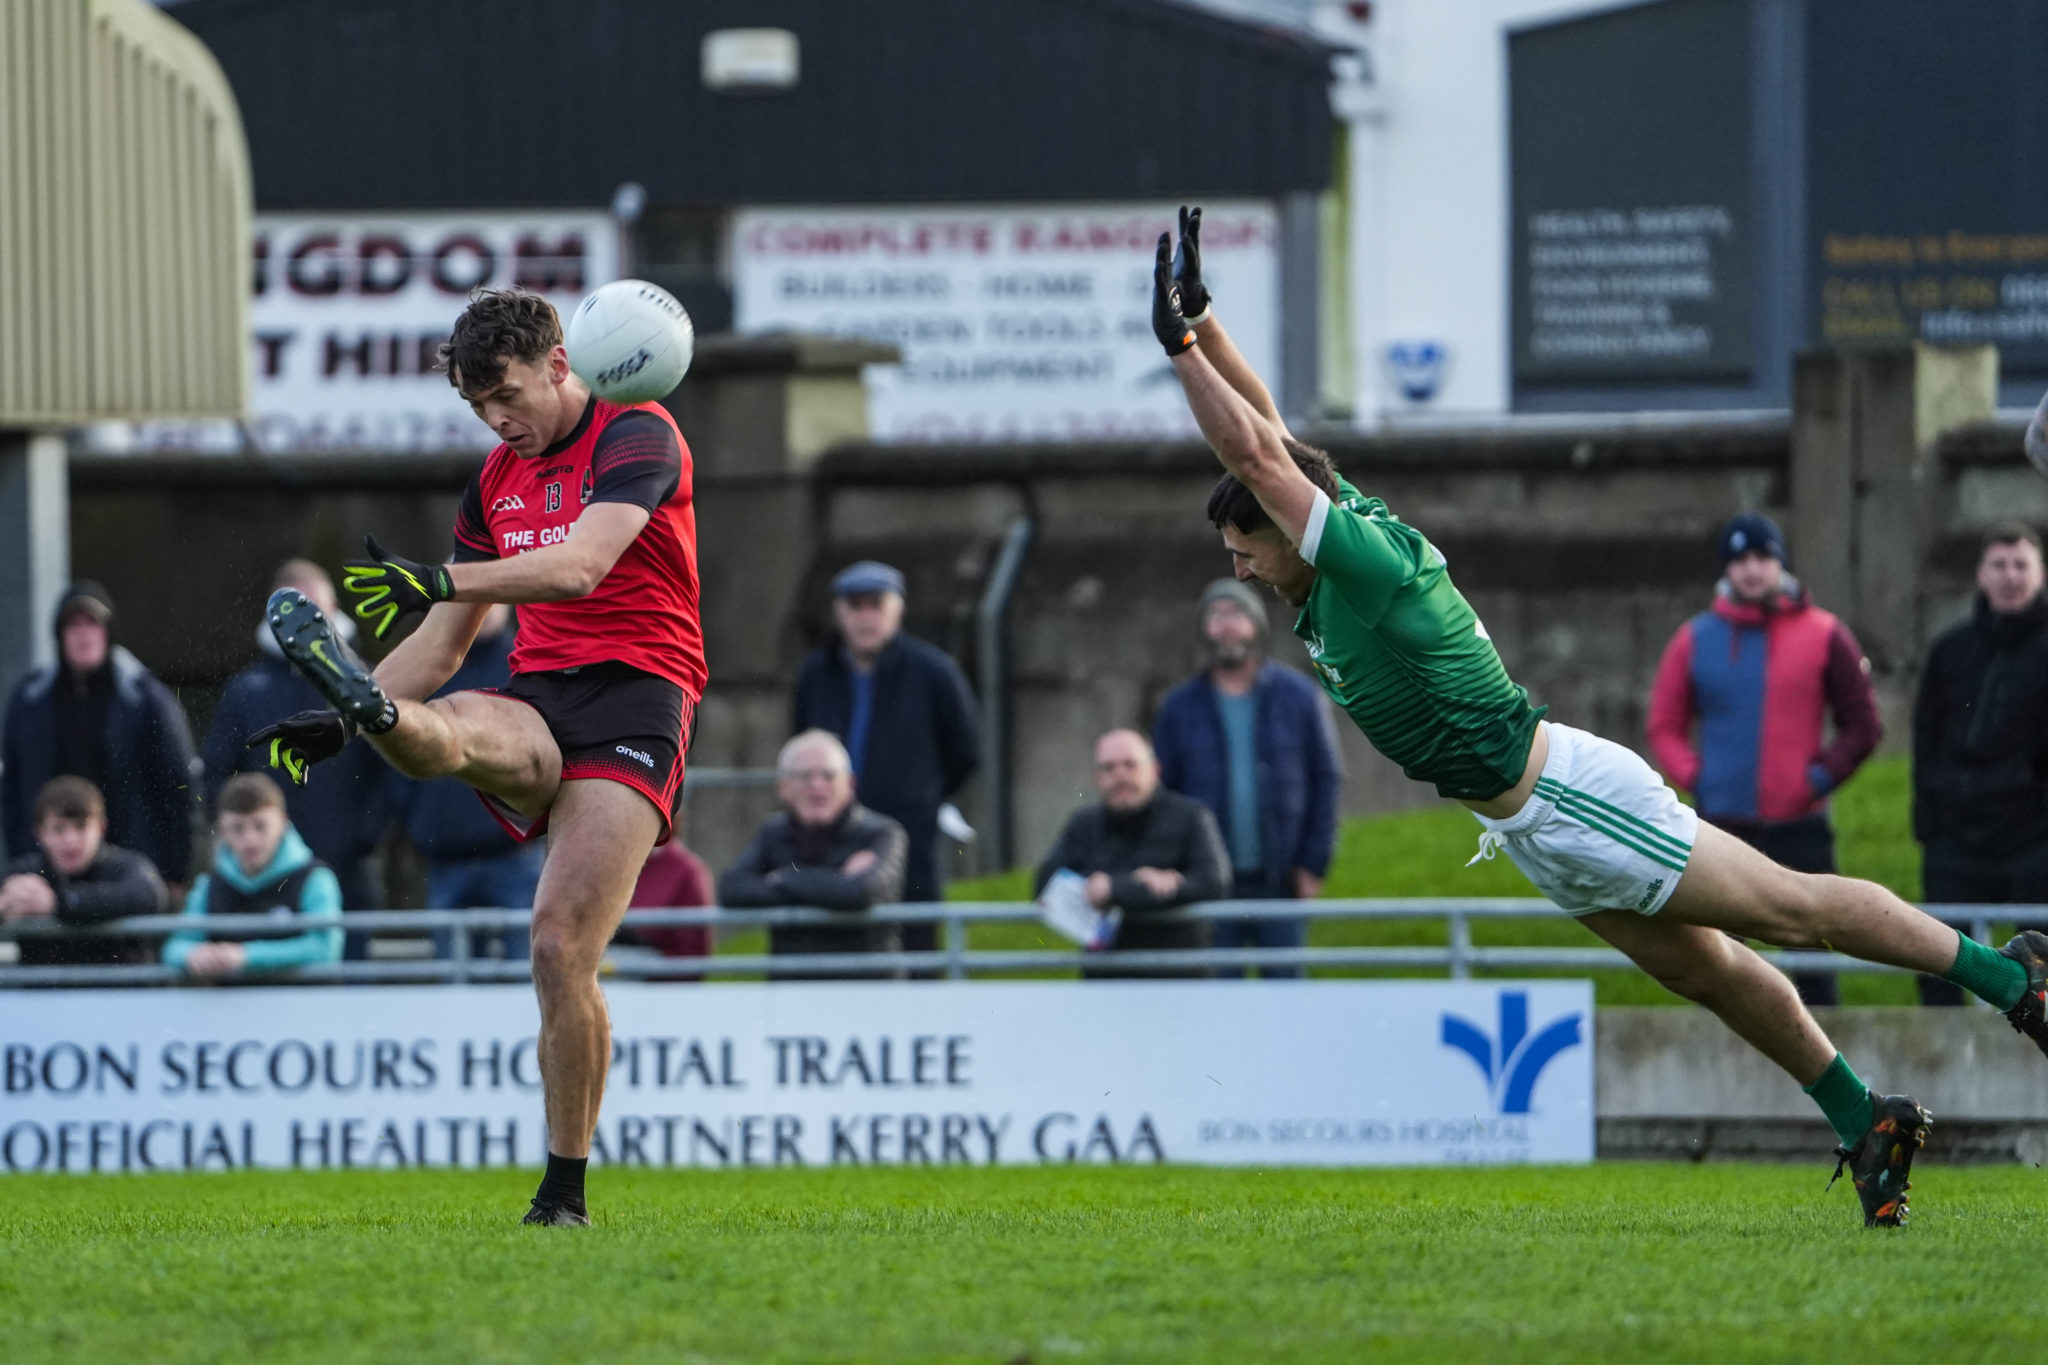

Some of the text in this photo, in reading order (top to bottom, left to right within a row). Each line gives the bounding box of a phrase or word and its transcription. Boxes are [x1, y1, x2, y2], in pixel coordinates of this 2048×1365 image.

[254, 235, 586, 296] GDOM
[545, 481, 562, 513] 13
[503, 522, 577, 549] THE GOL
[5, 1036, 973, 1095] BON SECOURS HOITAL TRALEE
[4, 1111, 1165, 1171] OFFICIAL HEALTH ARTNER KERRY GAA
